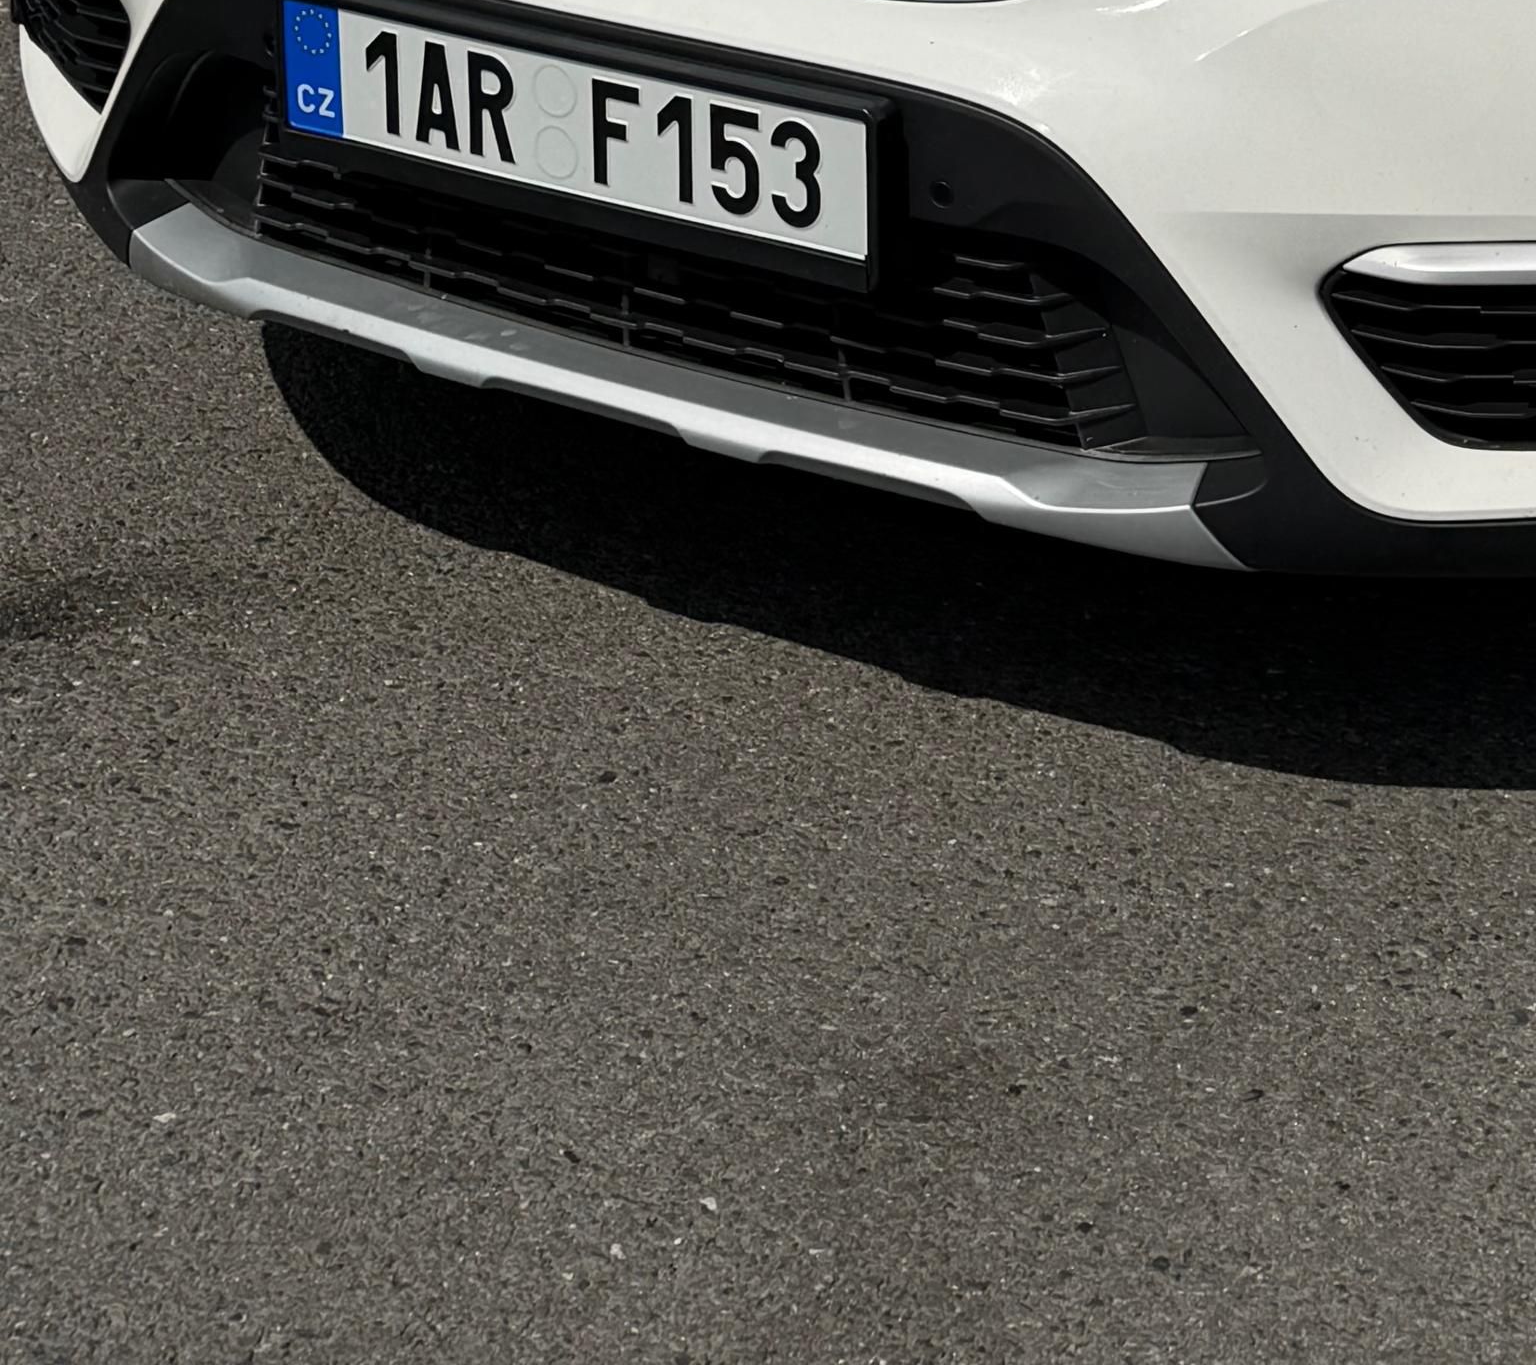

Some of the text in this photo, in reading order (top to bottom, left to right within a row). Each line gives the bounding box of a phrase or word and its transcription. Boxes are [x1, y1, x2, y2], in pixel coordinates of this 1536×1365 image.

[297, 83, 335, 118] CZ
[364, 30, 822, 229] 1AR F153
